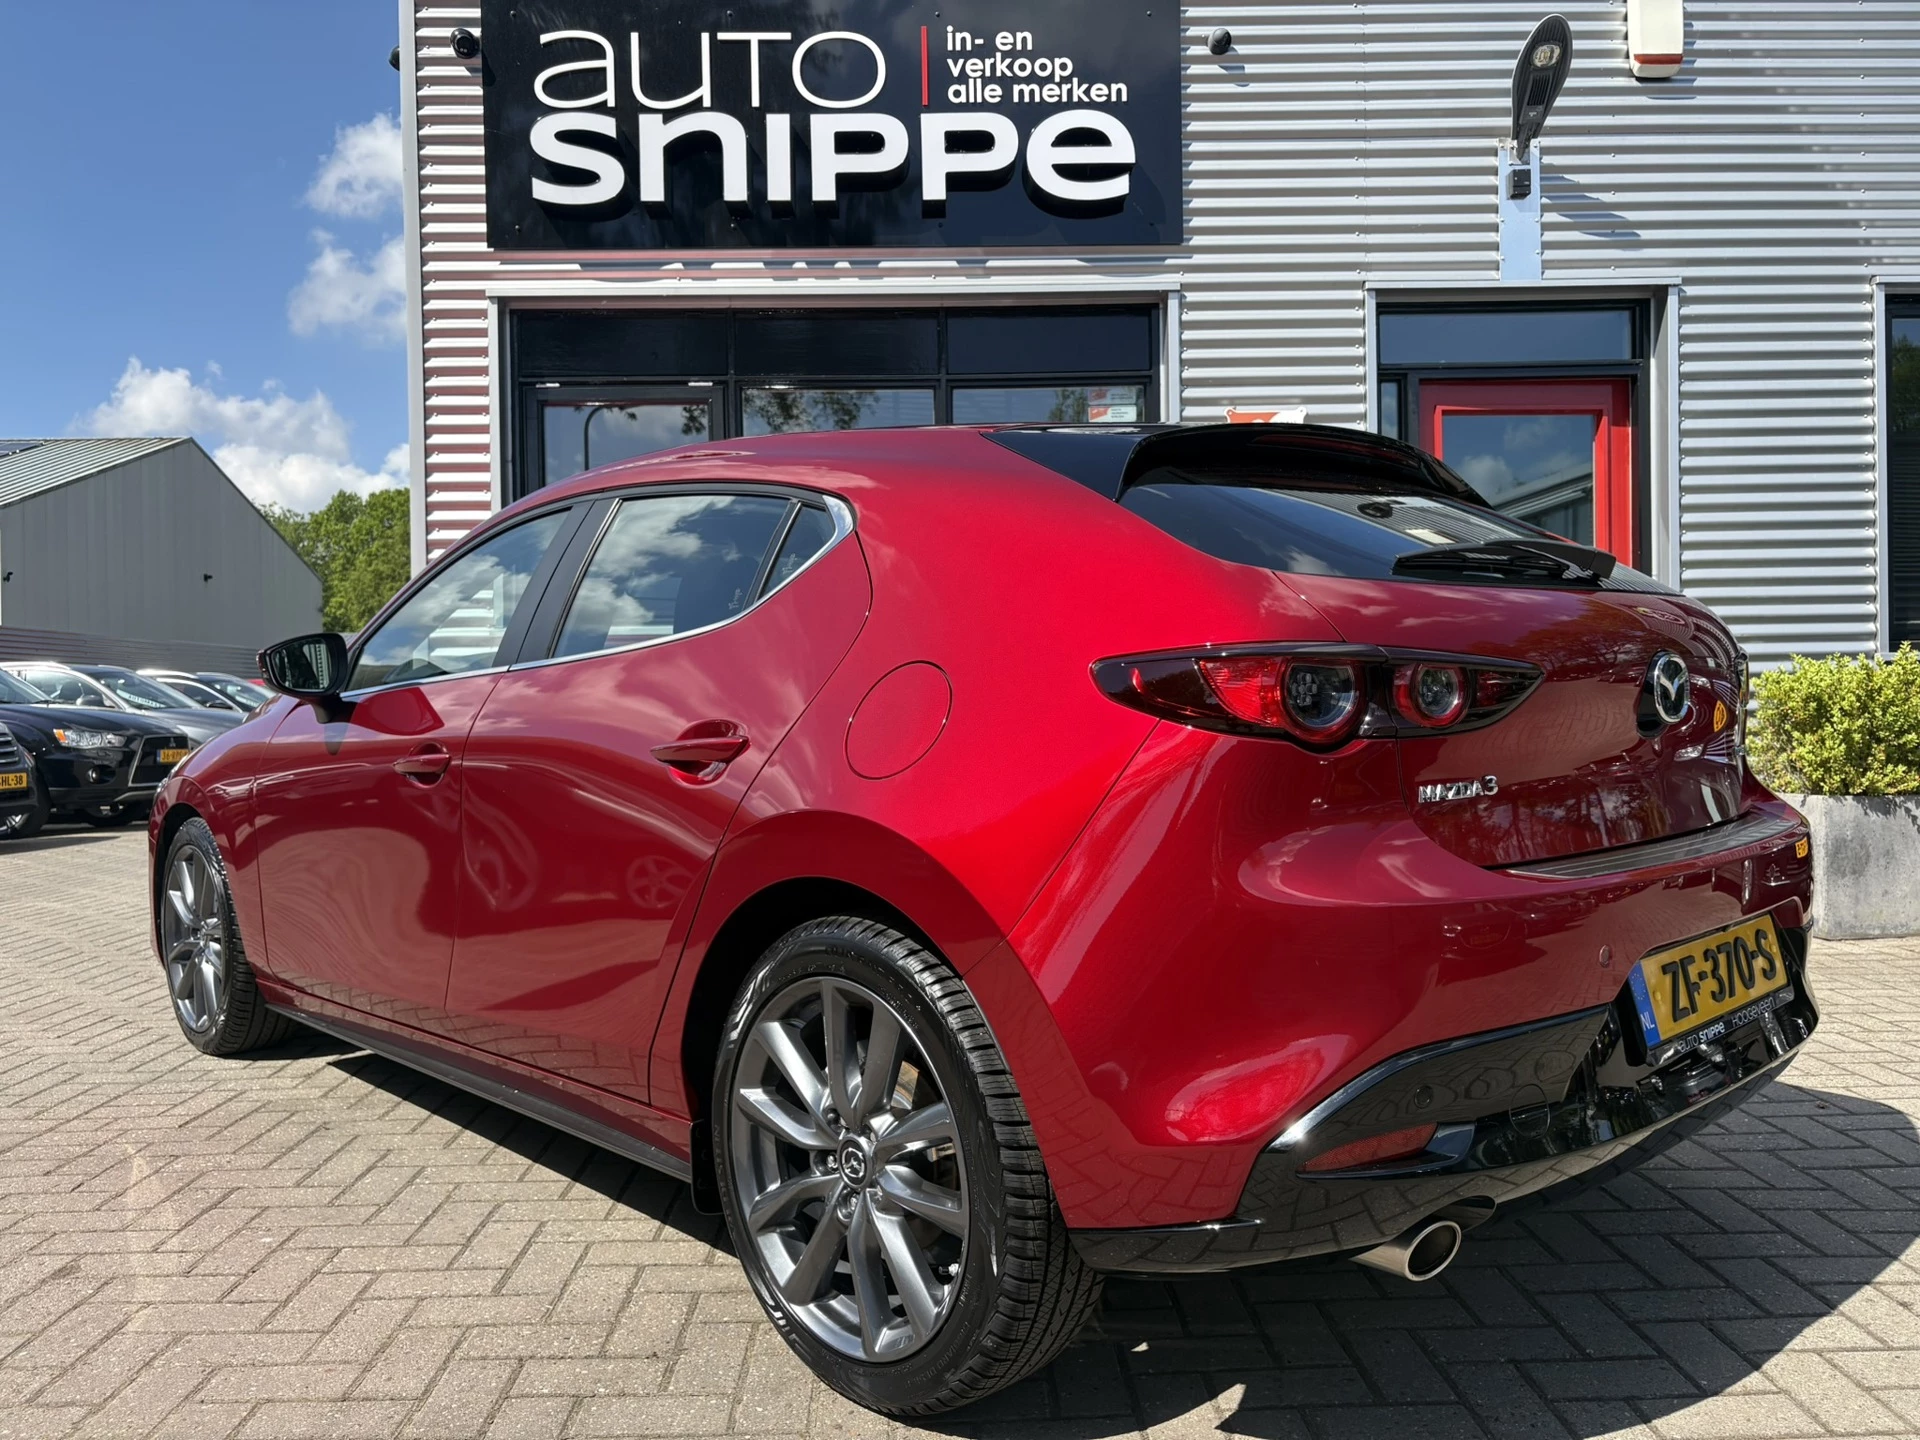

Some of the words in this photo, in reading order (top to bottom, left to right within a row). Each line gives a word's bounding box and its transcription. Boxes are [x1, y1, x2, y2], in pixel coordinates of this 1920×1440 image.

[946, 25, 984, 52] in-
[995, 30, 1033, 52] en
[946, 53, 1074, 82] verkoop
[947, 78, 1007, 104] alle
[1012, 77, 1129, 103] merken
[0, 774, 23, 787] HL-38
[1661, 929, 1777, 1023] ZF-370-S
[1640, 1011, 1656, 1032] NL
